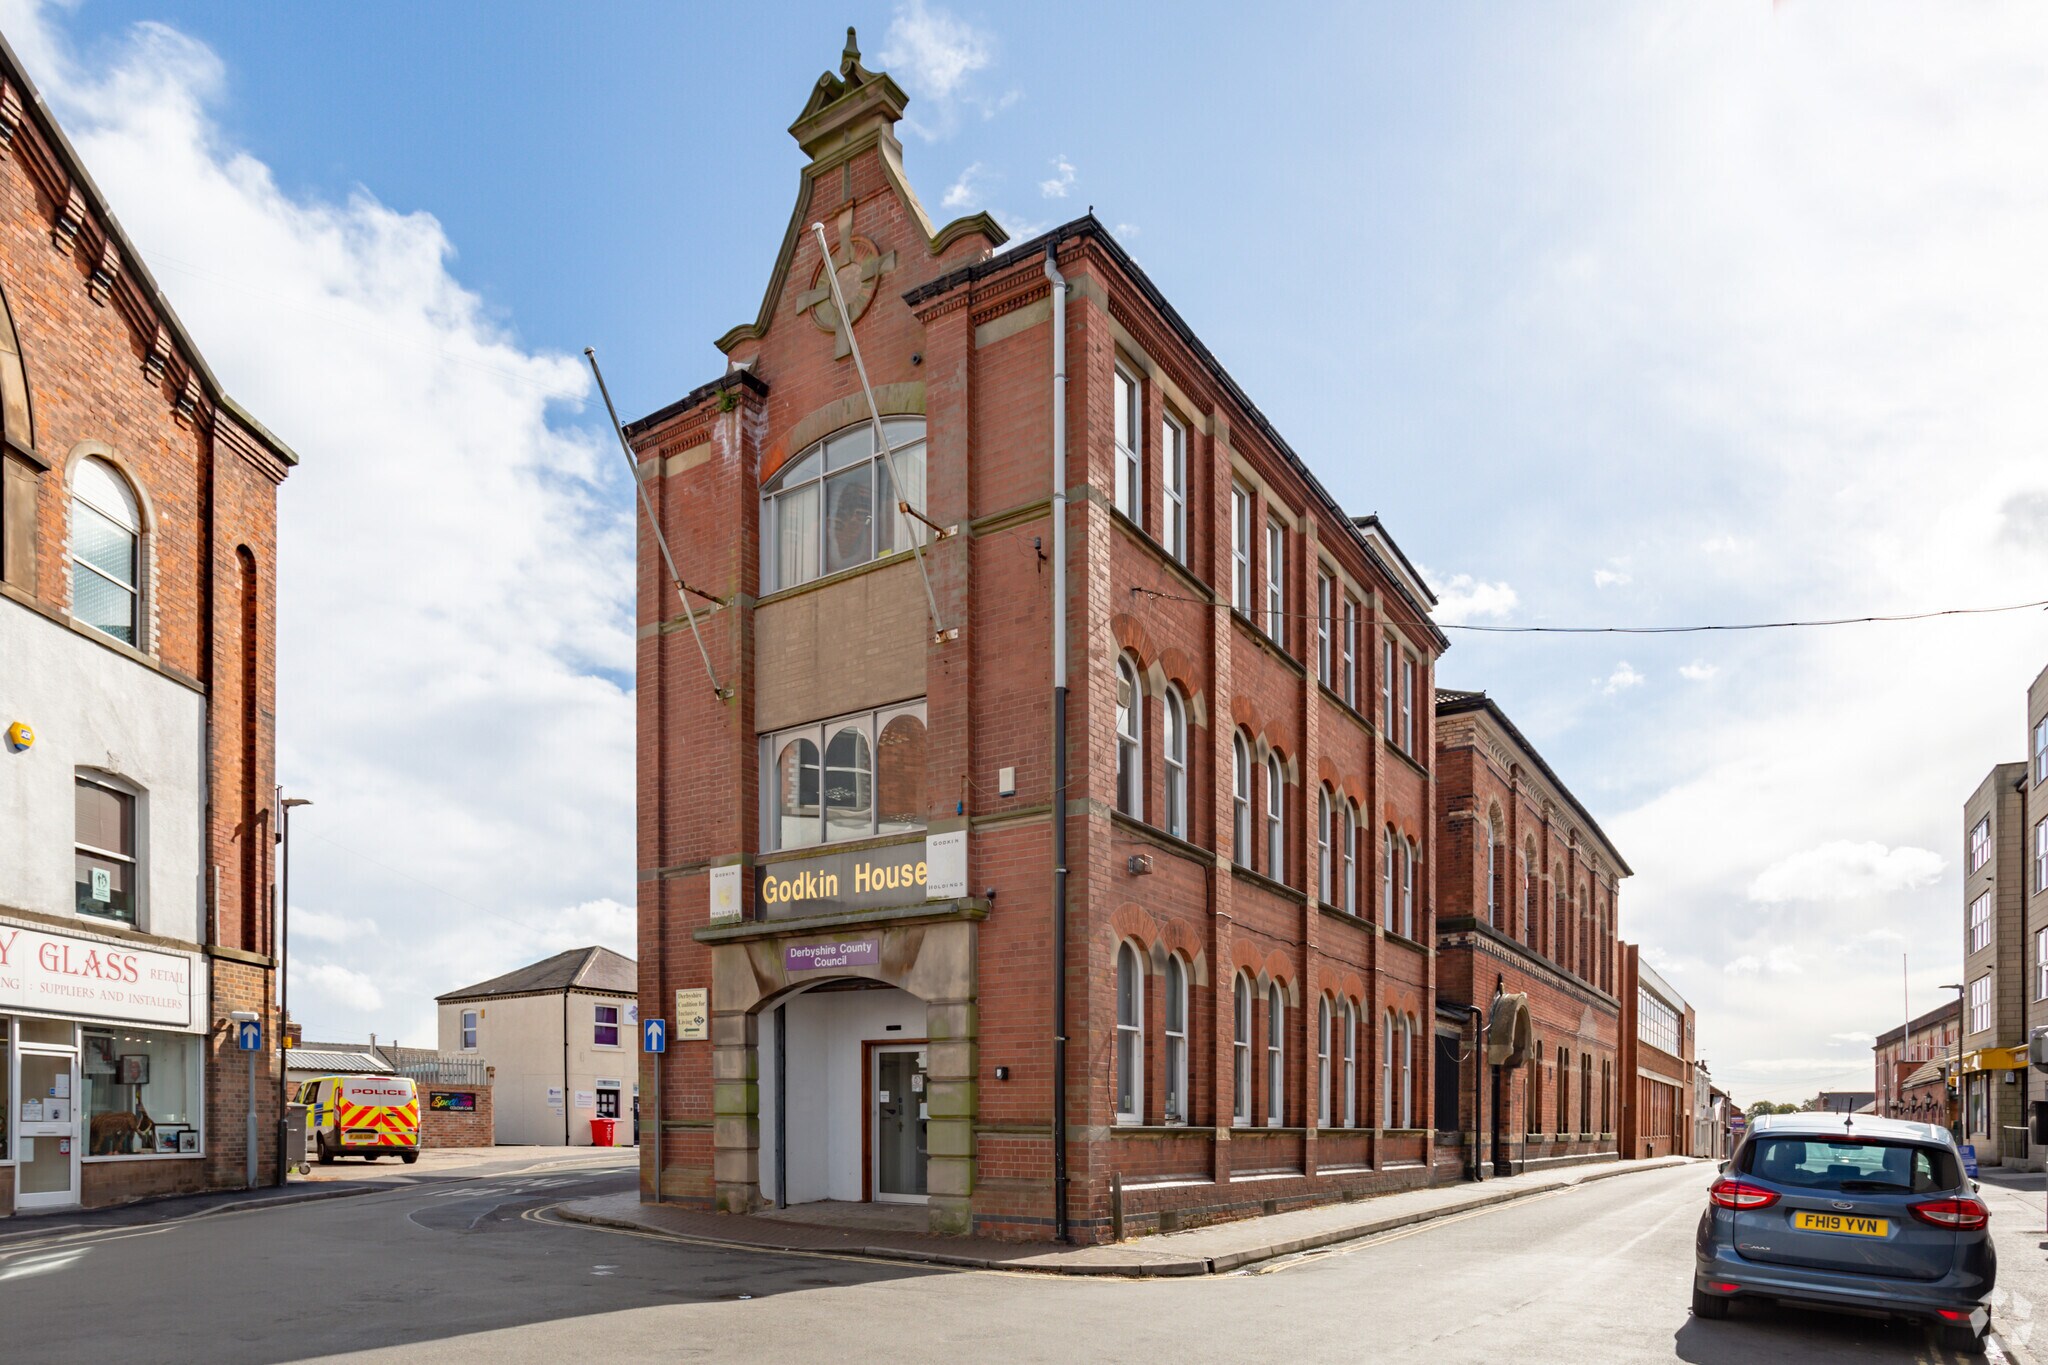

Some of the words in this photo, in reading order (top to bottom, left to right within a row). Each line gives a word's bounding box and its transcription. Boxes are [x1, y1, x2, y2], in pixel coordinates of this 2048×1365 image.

[933, 839, 959, 847] GODKIN
[762, 869, 839, 904] Godkin
[854, 861, 928, 894] House
[790, 945, 836, 959] Derbyshire
[839, 941, 872, 954] County
[38, 942, 139, 983] GLASS
[150, 968, 185, 984] RETAIL
[814, 955, 847, 967] Council
[40, 982, 95, 999] SUPPLIERS
[100, 990, 124, 1002] AND
[129, 993, 183, 1009] INSTALLERS
[351, 1088, 406, 1096] POLICE
[1805, 1214, 1840, 1229] FH19
[1846, 1219, 1877, 1233] YVN
